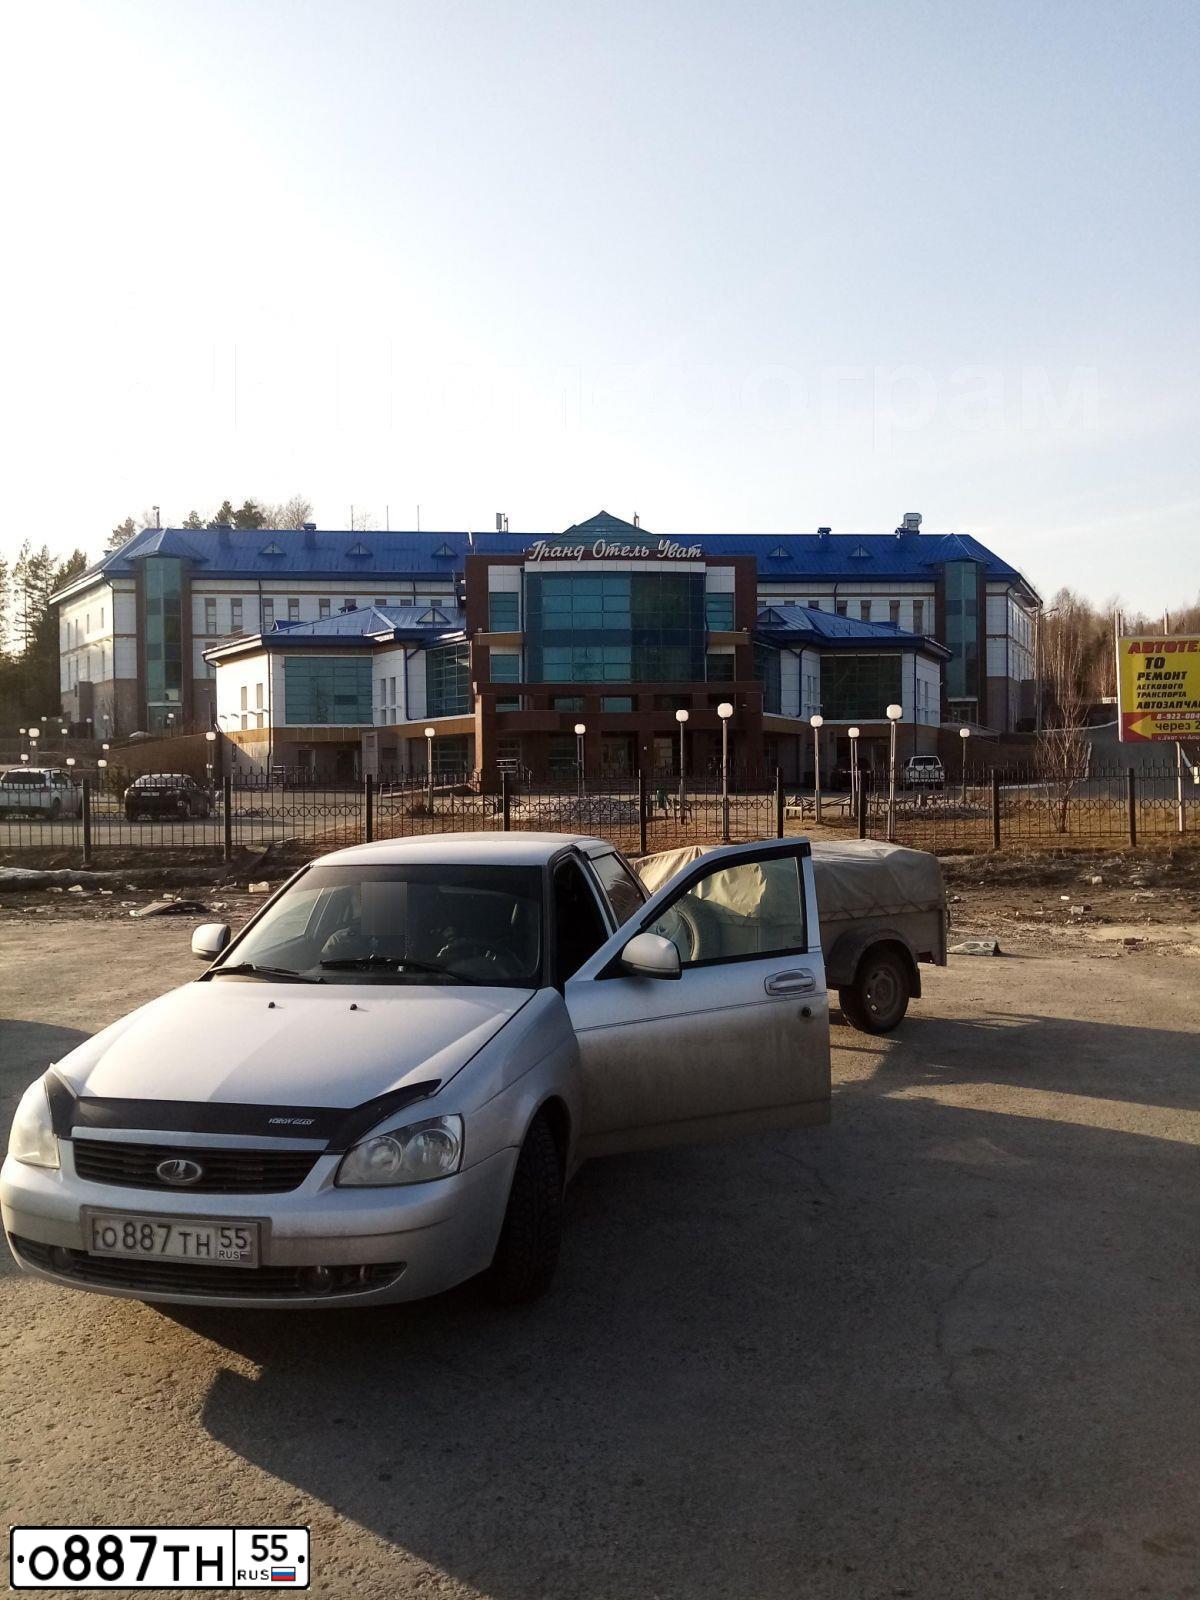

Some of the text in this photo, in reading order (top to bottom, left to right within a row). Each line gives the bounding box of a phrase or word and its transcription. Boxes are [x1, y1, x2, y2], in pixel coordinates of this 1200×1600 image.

[527, 539, 702, 562] Гранд Отель Уват
[1128, 640, 1200, 654] АВТОТЕ
[1145, 657, 1166, 669] ТО
[1137, 671, 1187, 680] РЕМОНТ
[1155, 722, 1191, 732] через
[102, 1222, 247, 1256] О887ТН 55
[218, 1251, 240, 1259] RUS
